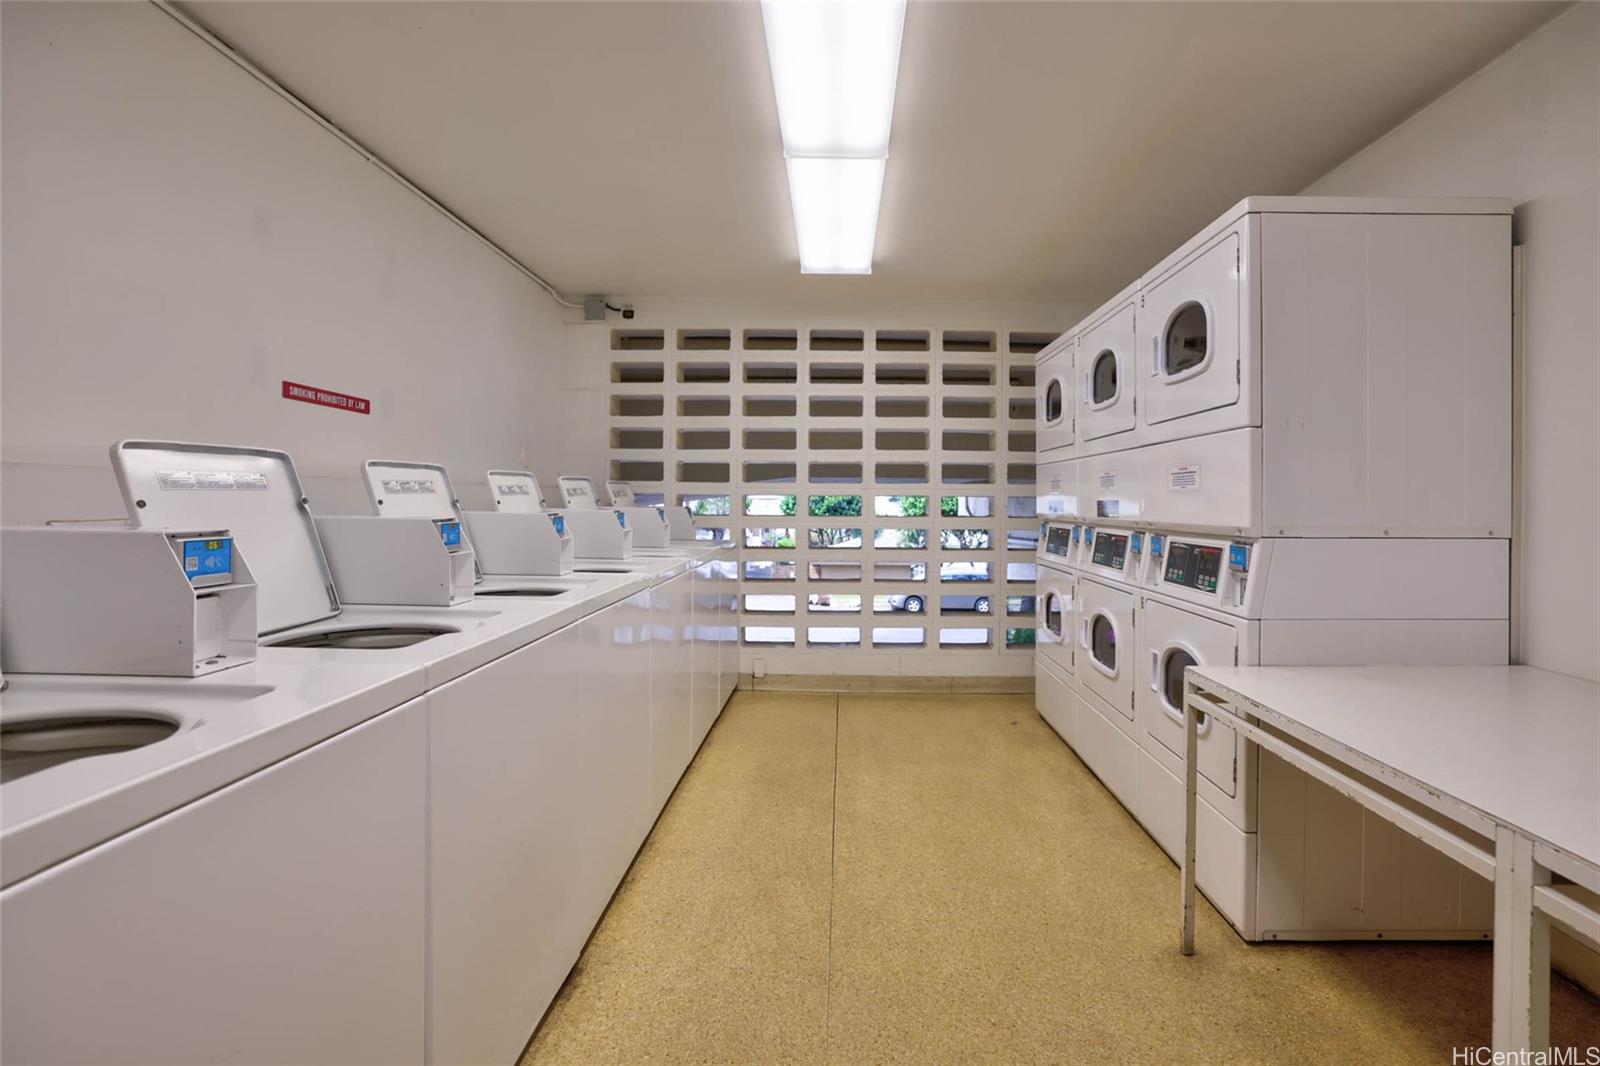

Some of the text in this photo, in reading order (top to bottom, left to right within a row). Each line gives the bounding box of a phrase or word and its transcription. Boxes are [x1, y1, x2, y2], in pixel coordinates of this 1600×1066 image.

[289, 386, 366, 410] SMOKING PROHIBITED BY LAW
